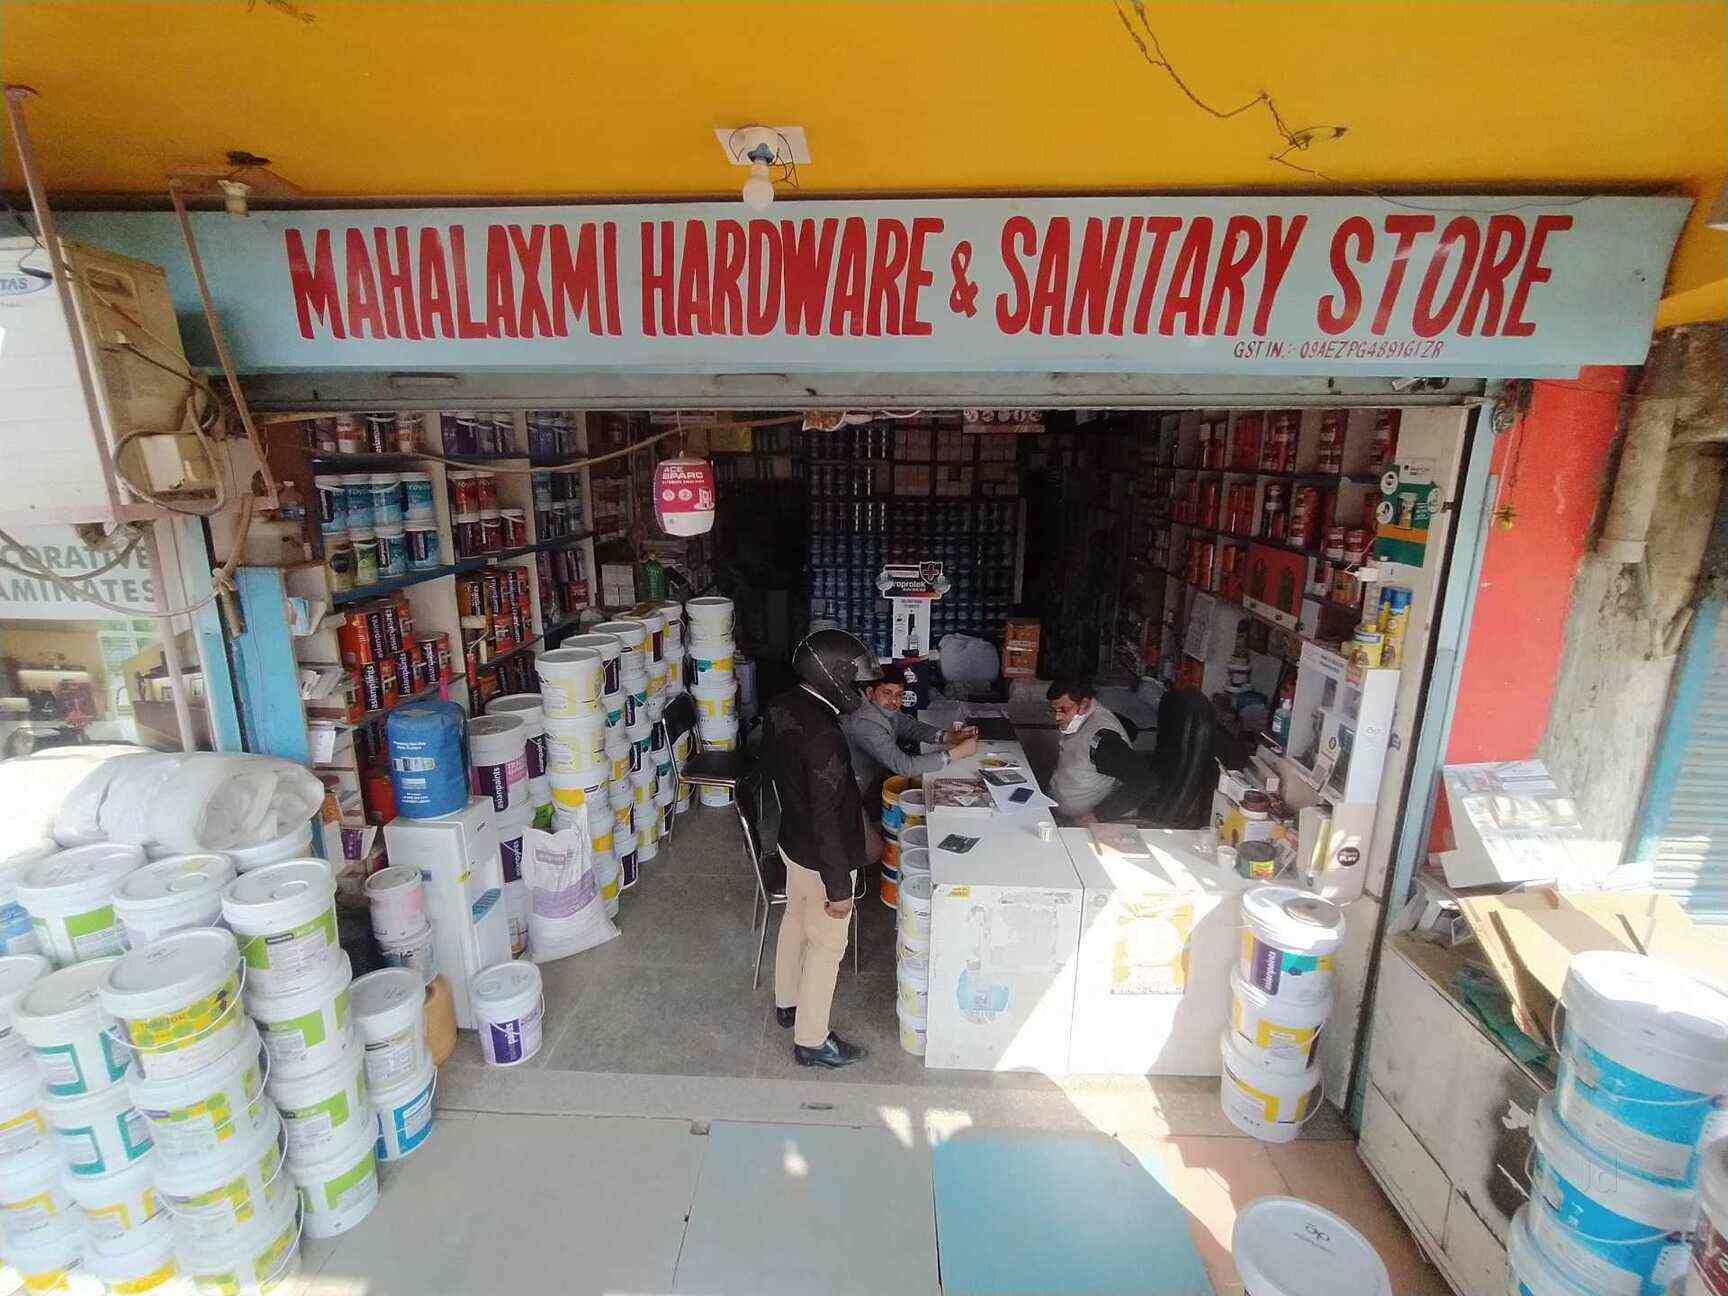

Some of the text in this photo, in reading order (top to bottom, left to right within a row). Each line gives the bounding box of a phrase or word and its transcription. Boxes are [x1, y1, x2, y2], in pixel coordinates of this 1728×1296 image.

[284, 214, 1573, 340] MAHALAXMI HARDWARE & SANITARY STORE
[366, 664, 379, 709] asianpaints
[492, 767, 505, 809] asianpaints
